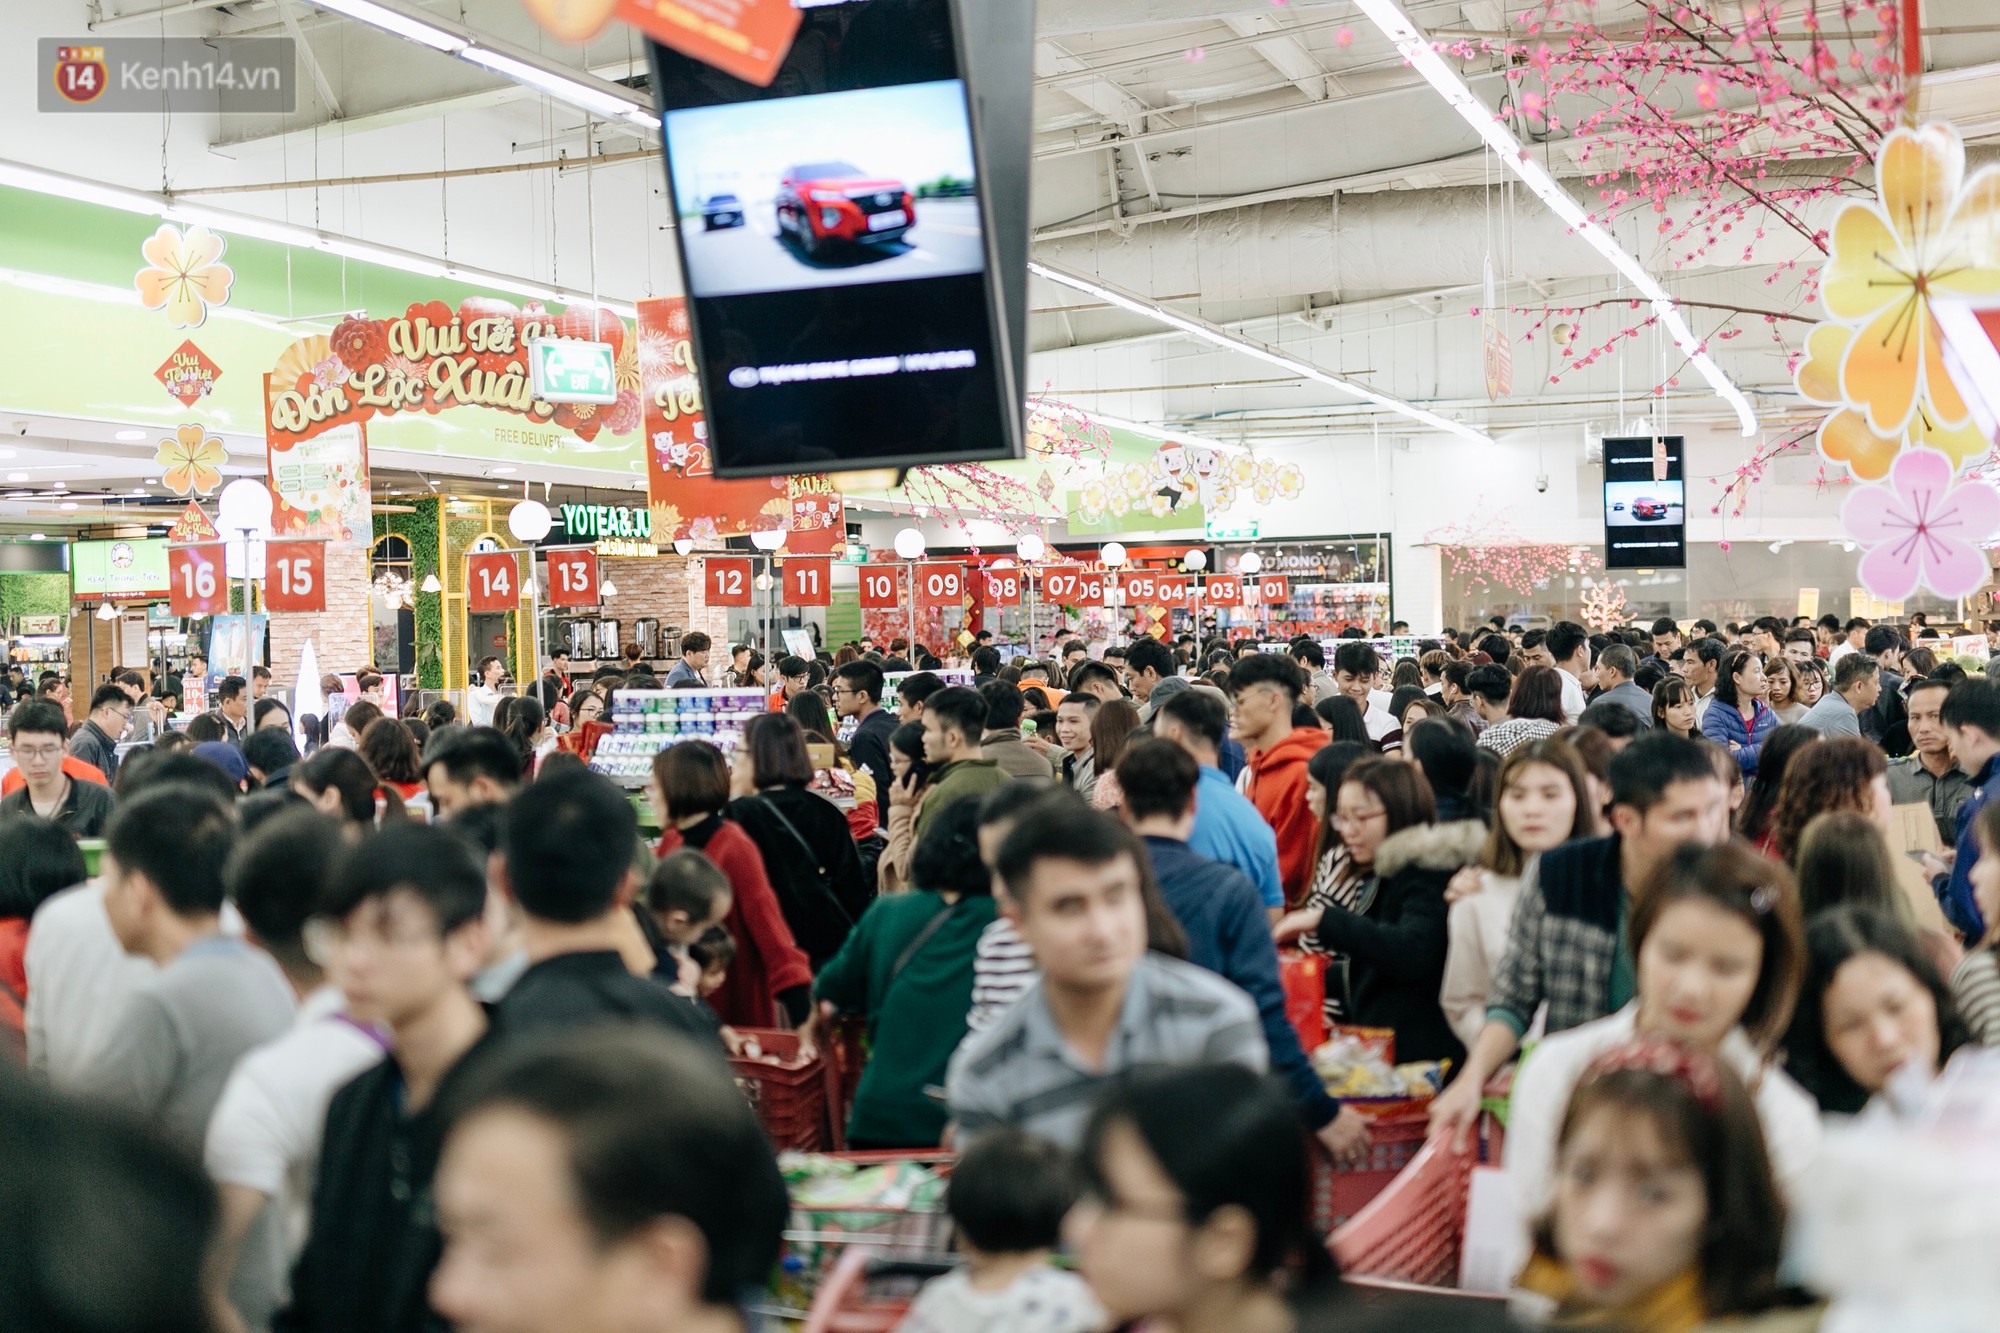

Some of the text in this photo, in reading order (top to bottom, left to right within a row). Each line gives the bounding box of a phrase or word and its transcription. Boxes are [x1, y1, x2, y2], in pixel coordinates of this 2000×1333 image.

[388, 315, 467, 362] Vui
[466, 316, 516, 354] Tết
[173, 352, 200, 368] Vui
[571, 374, 590, 390] EXIT
[271, 382, 349, 433] Đón
[350, 363, 424, 409] Lộc
[494, 428, 519, 445] FREE
[801, 475, 834, 496] Việt
[180, 562, 216, 599] 16
[276, 558, 313, 595] 15
[478, 567, 510, 598] 14
[558, 562, 589, 592] 13
[715, 570, 743, 595] 12
[796, 570, 818, 595] 11
[866, 576, 891, 598] 10
[928, 574, 959, 597] 09
[1049, 576, 1077, 596] 07
[989, 577, 1017, 598] 08
[1129, 579, 1155, 597] 05
[1159, 584, 1184, 601] 04
[1210, 582, 1234, 599] 03
[1265, 582, 1284, 598] 01
